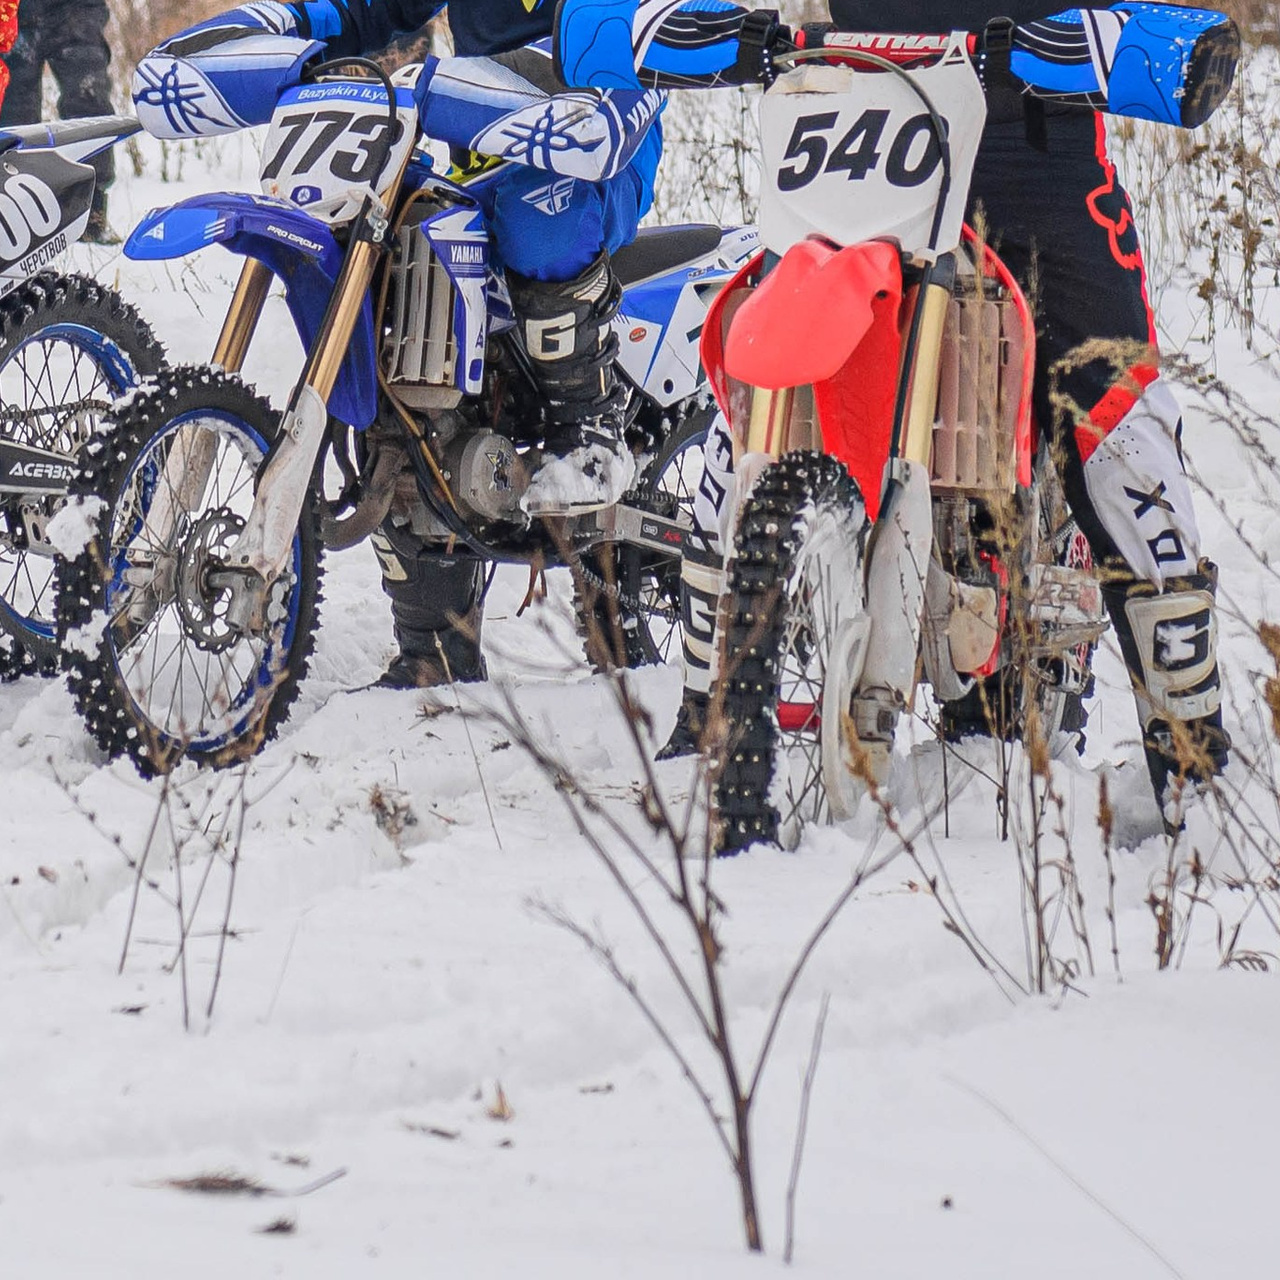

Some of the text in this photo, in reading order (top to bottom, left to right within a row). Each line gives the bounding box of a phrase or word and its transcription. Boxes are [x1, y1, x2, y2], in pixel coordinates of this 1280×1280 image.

[260, 111, 405, 183] 773
[773, 109, 950, 192] 540
[267, 224, 288, 239] PRO
[19, 232, 67, 277] ЧЕРСТВОВ
[451, 245, 484, 264] YAMAHA
[8, 461, 80, 480] ACERBI
